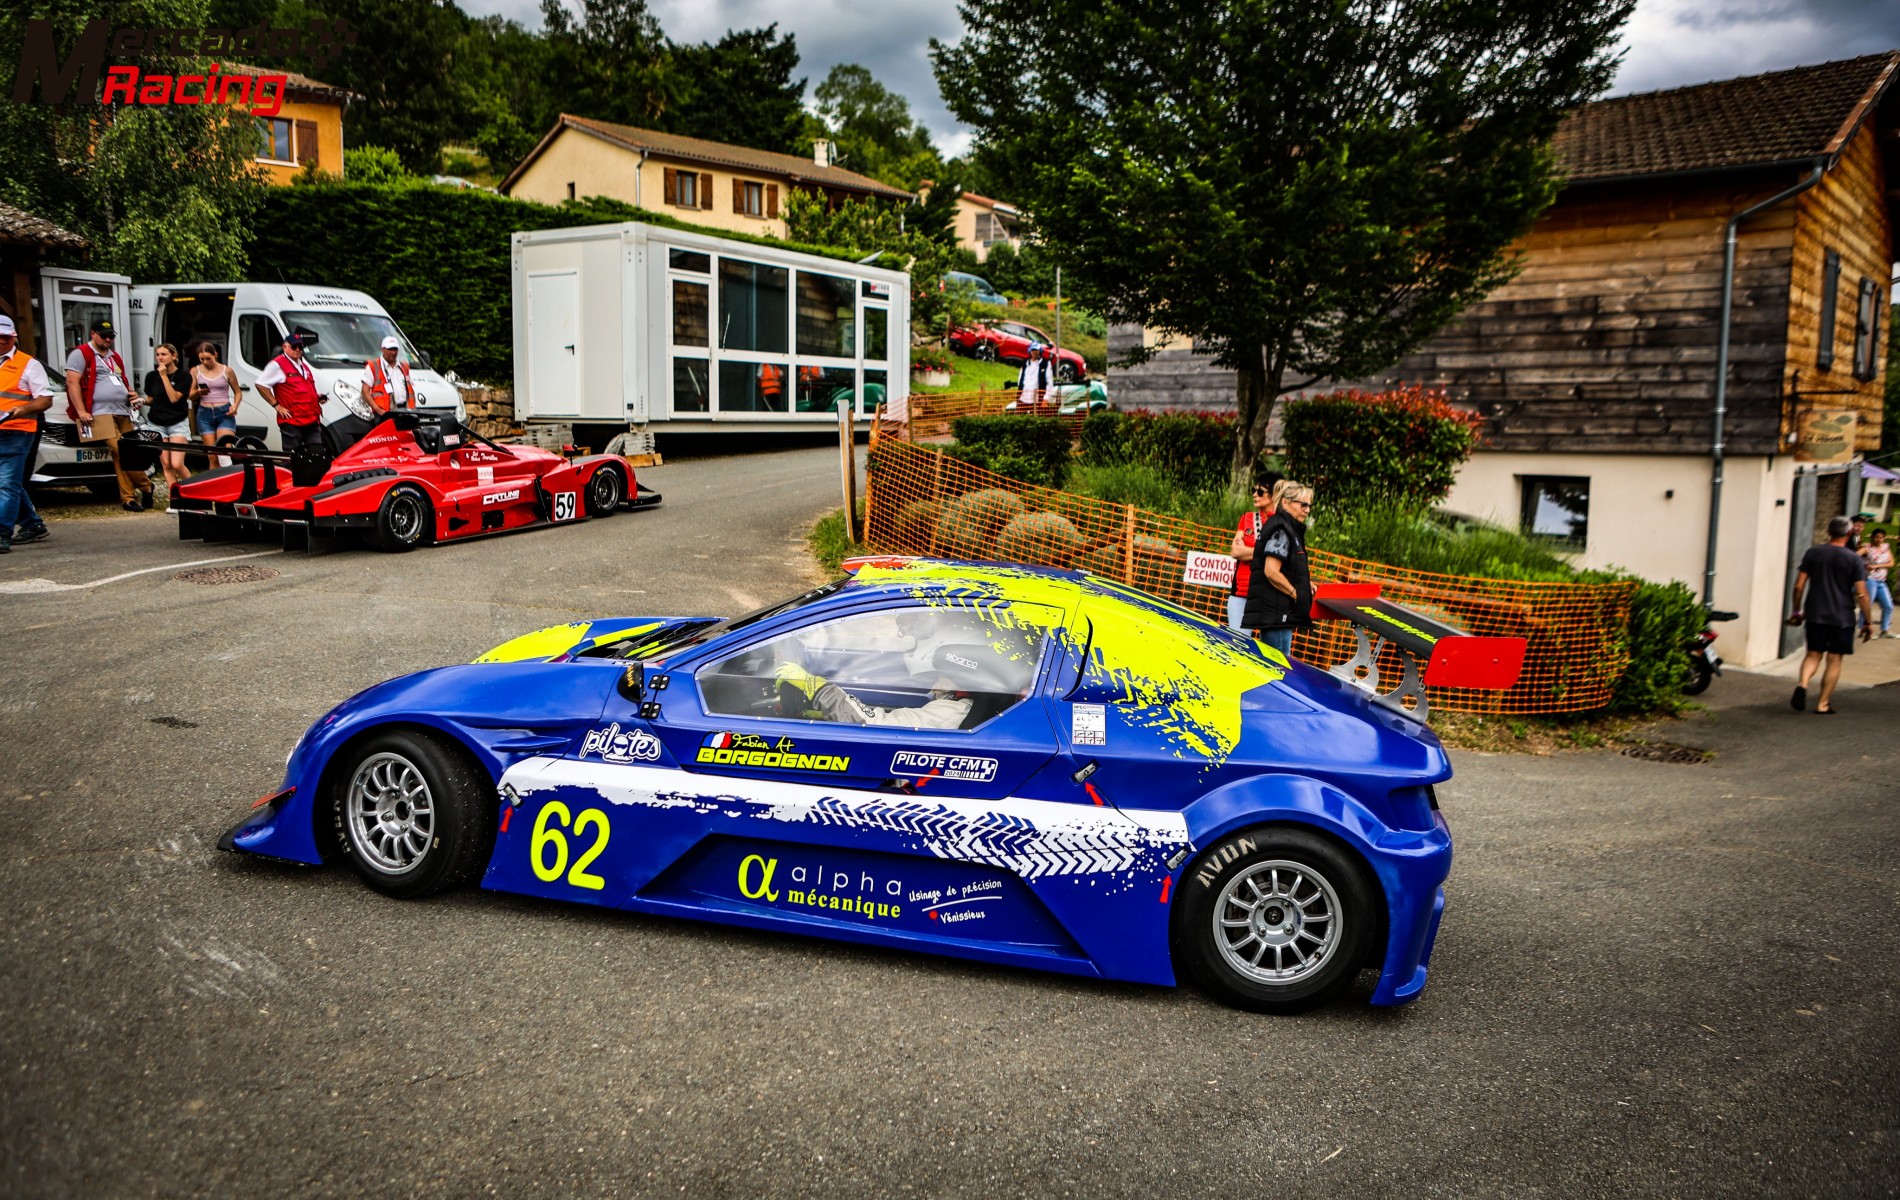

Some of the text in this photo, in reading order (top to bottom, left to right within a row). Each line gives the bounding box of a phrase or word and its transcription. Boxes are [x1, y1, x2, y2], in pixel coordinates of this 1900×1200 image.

[300, 300, 369, 310] SONORISATION
[368, 435, 398, 444] HONDA
[555, 493, 575, 519] 59
[696, 748, 850, 771] BORGOGNON
[896, 753, 981, 771] PILOTE CFM
[530, 800, 611, 890] 62
[1197, 835, 1258, 888] AVON
[791, 865, 902, 896] alpha
[909, 880, 1002, 904] Usinage de précision
[787, 888, 901, 919] mécanique
[940, 910, 985, 924] Vénissieux
